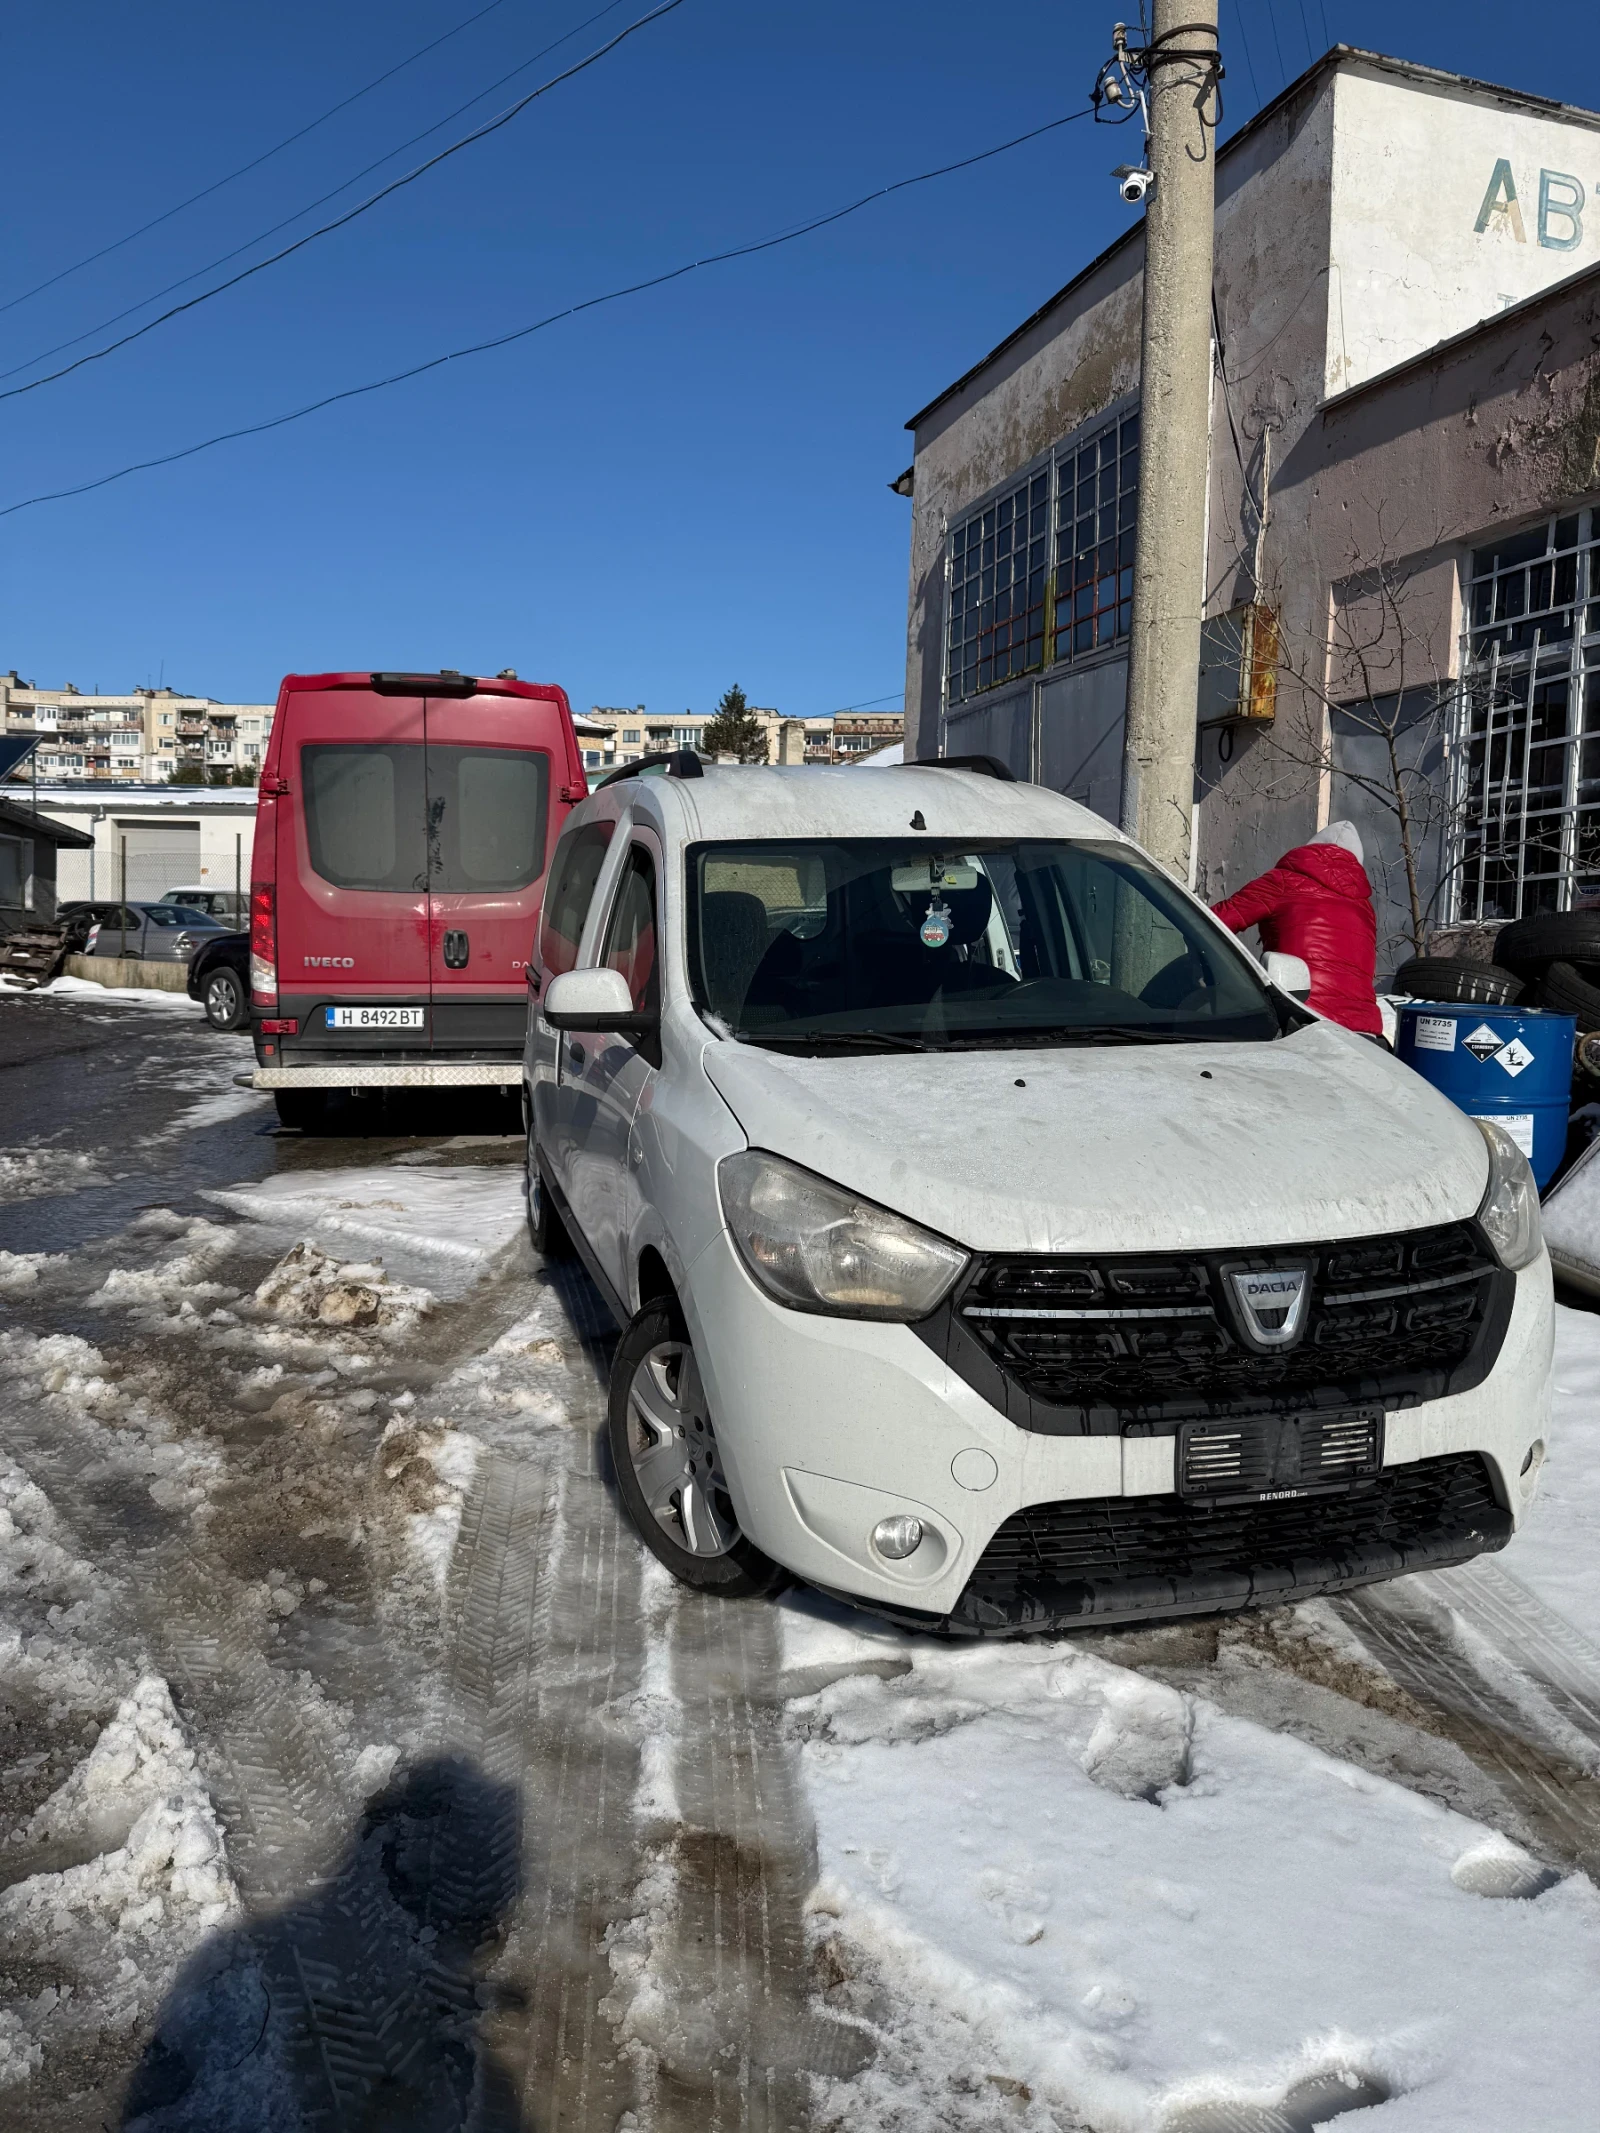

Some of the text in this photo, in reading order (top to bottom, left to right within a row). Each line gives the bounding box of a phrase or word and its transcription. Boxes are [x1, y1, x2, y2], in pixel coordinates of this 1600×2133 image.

[1473, 157, 1600, 252] АВ
[303, 956, 355, 968] IVECO
[1420, 1017, 1452, 1028] UN 2735
[1247, 1281, 1298, 1295] DACIA
